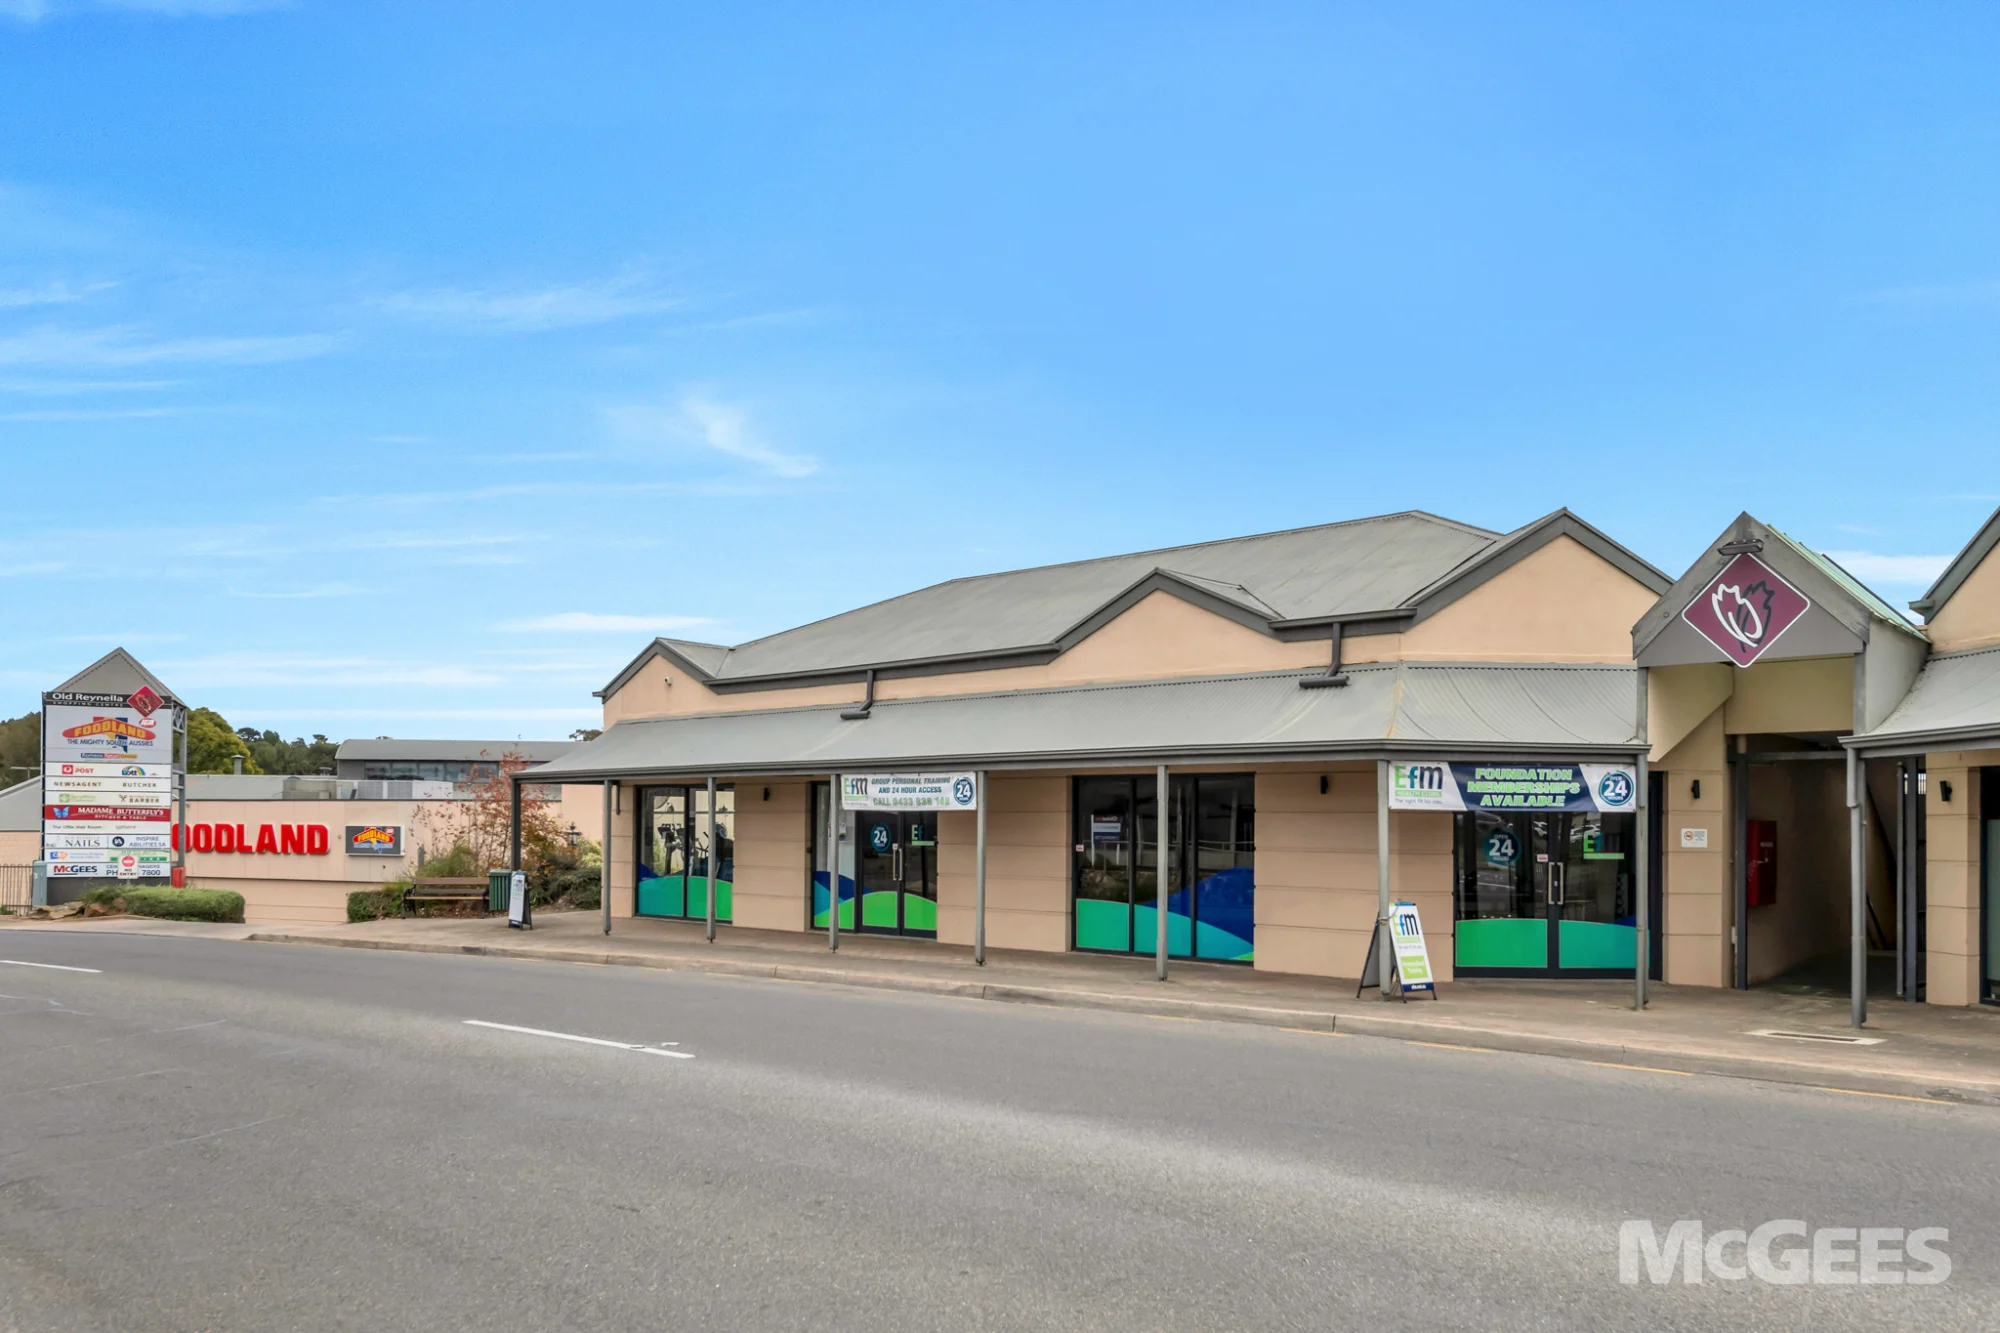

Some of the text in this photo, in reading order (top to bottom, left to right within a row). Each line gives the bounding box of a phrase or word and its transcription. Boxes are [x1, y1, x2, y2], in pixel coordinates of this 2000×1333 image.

[52, 692, 124, 703] Old Reynella
[74, 718, 146, 738] FOODLAND
[892, 777, 922, 785] PERSONAL
[923, 776, 951, 784] TRAINING
[1394, 765, 1443, 789] Efm
[1475, 768, 1572, 781] FOUNDATION
[918, 786, 942, 794] ACCESS
[957, 784, 971, 797] 24
[1467, 782, 1580, 794] MEMBERSHIPS
[1603, 780, 1628, 797] 24
[873, 797, 891, 806] CALL
[1480, 795, 1566, 807] AVAILABLE
[172, 823, 329, 854] OODLAND
[357, 827, 391, 843] FOODLAND
[873, 830, 888, 844] 24
[912, 824, 924, 840] Ef
[1488, 839, 1514, 856] 24
[53, 865, 98, 873] McGEES
